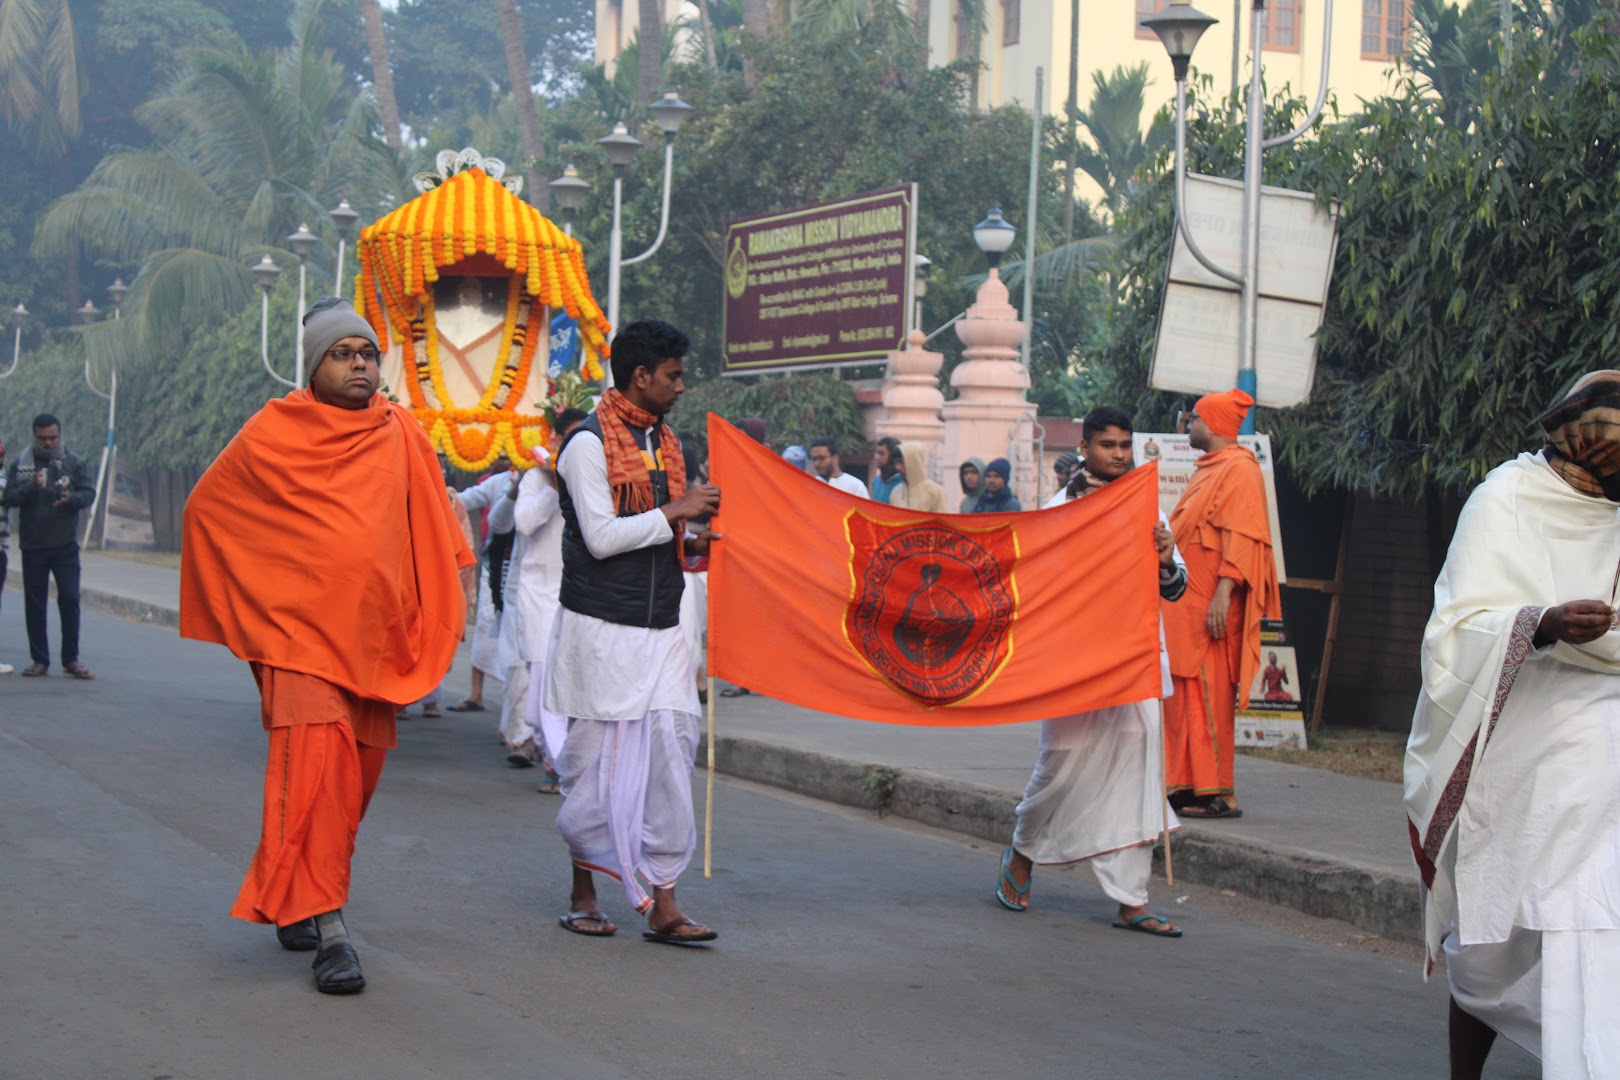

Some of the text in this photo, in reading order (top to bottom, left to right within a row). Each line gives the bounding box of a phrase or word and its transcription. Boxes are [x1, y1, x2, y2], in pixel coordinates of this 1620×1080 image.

[804, 217, 839, 246] MISSION
[1159, 472, 1190, 484] wami
[900, 532, 957, 551] MISSION
[949, 652, 988, 694] HOWRAH
